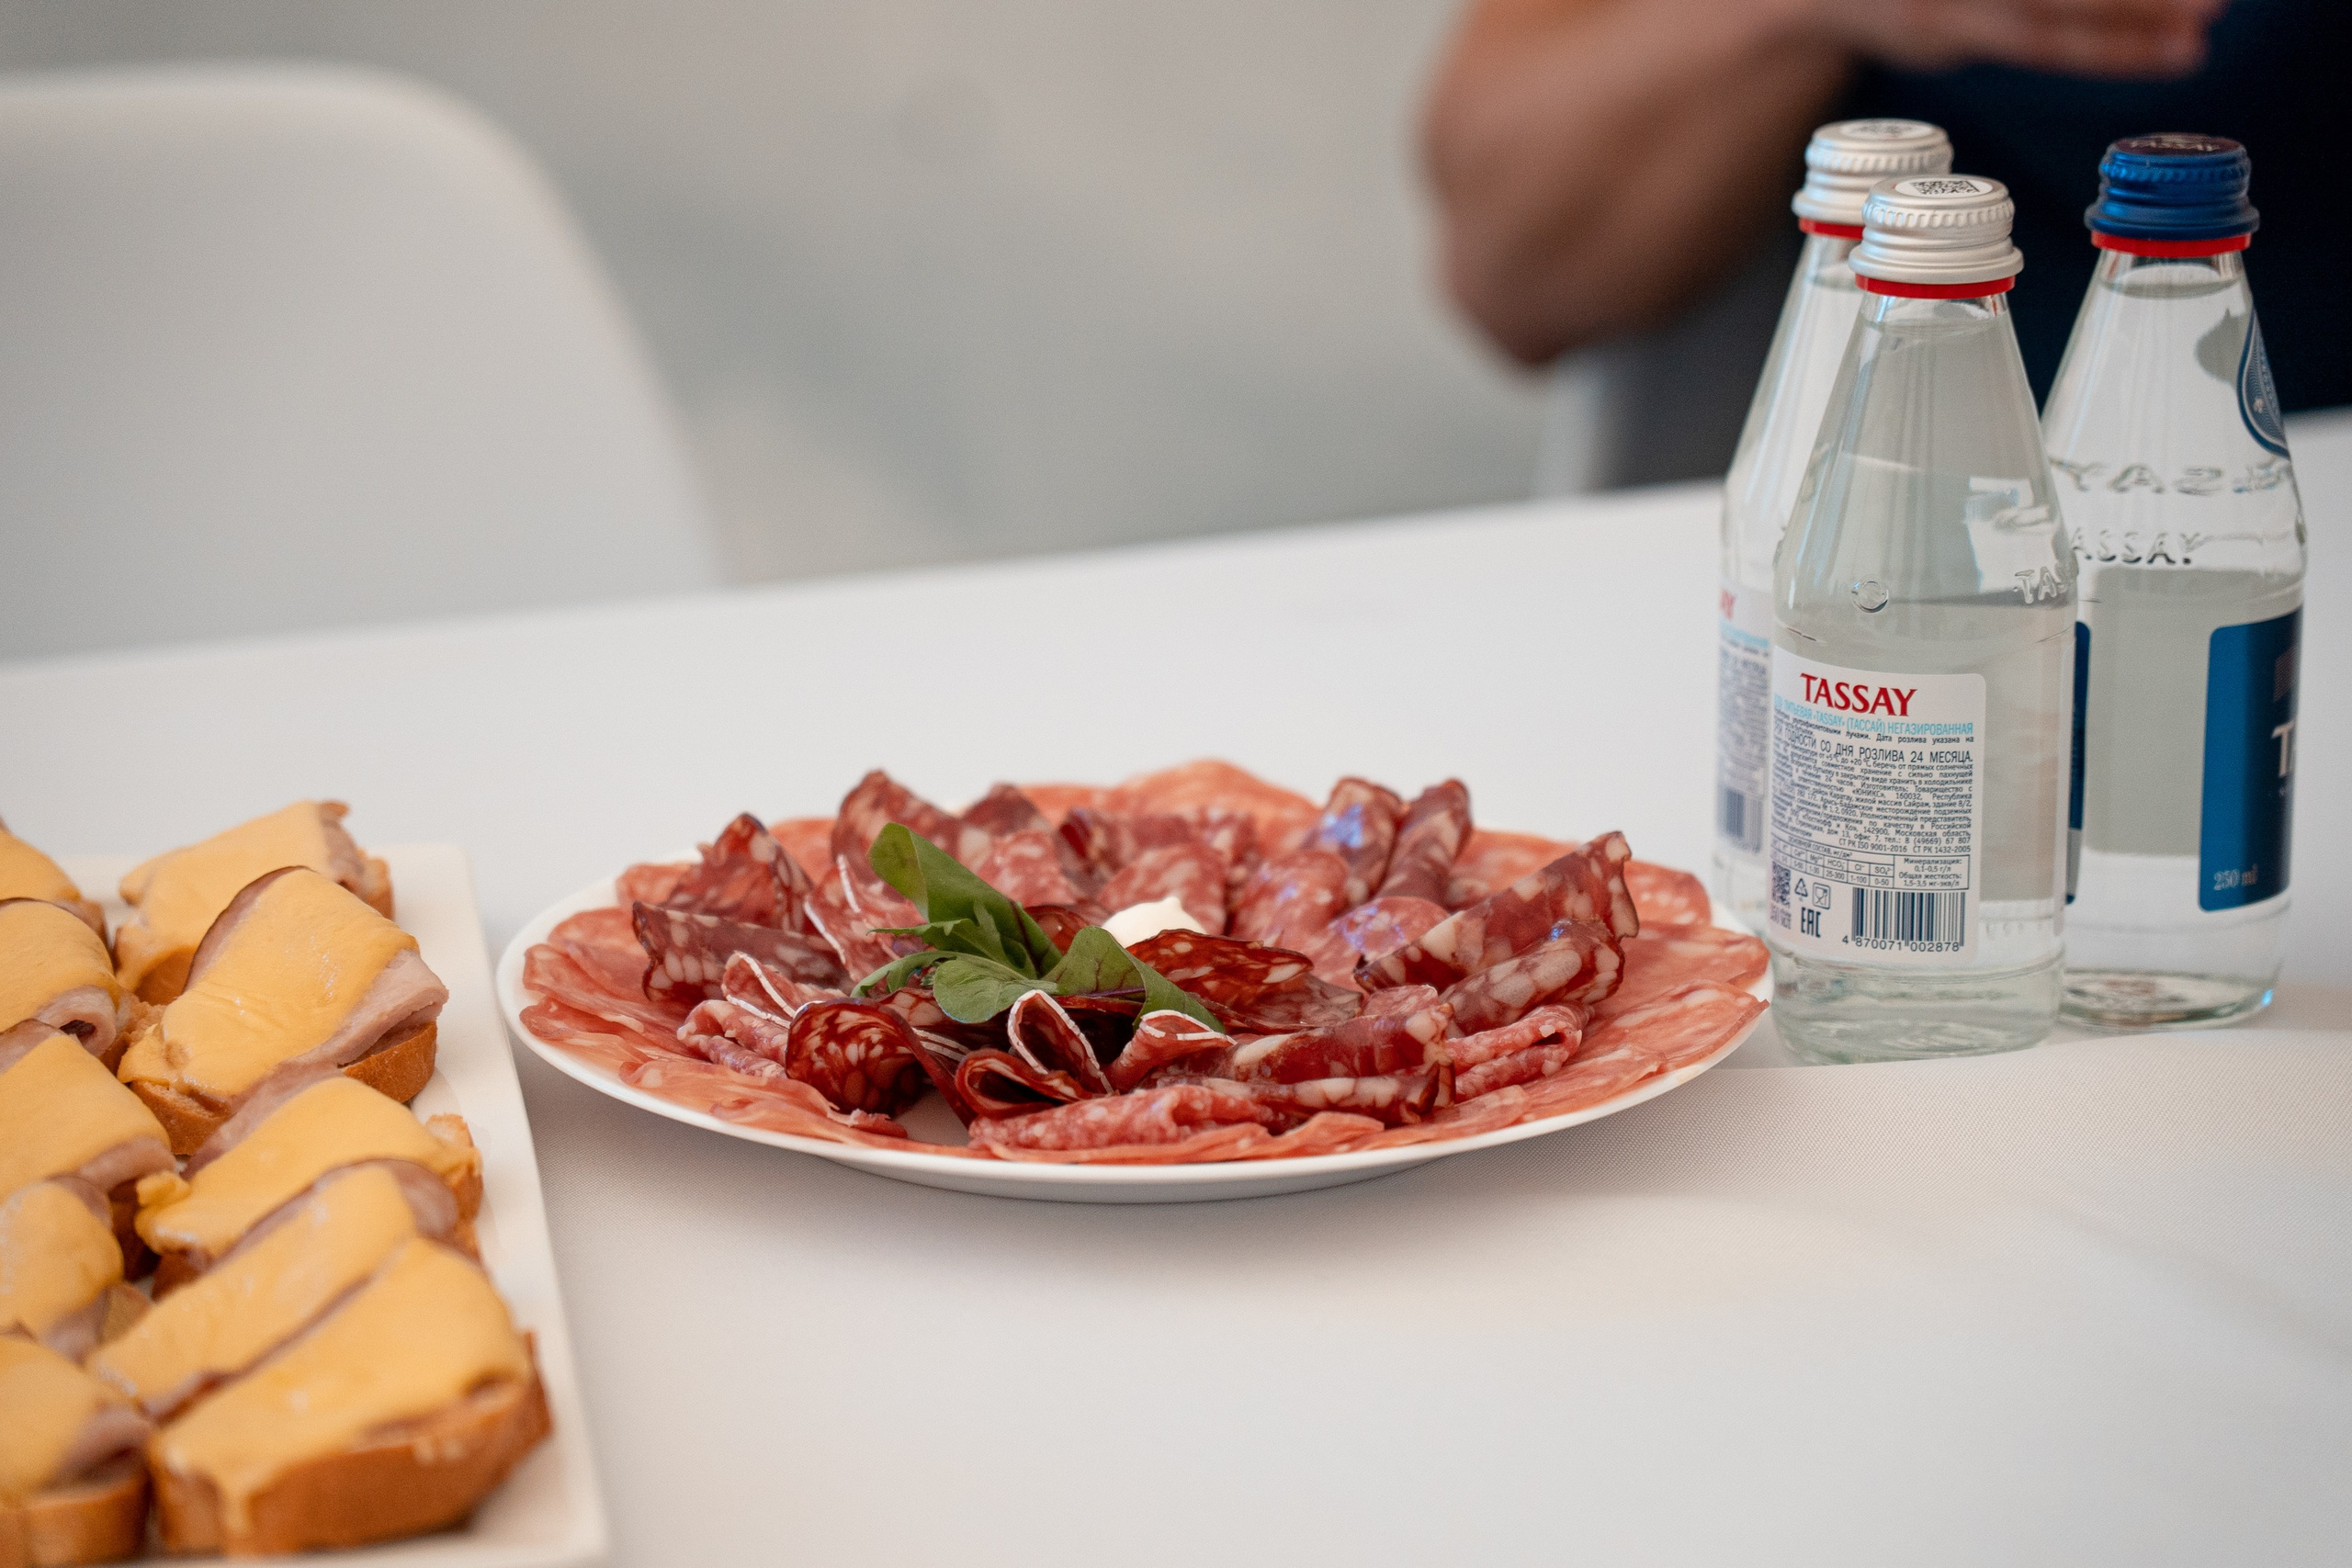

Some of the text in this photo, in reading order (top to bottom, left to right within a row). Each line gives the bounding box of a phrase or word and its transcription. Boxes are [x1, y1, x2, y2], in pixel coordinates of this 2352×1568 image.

[1800, 672, 1917, 716] TASSAY
[1847, 717, 1885, 736] (ТАССАЙ)
[1888, 722, 1973, 736] НЕГАЗИРОВАННАЯ
[1846, 729, 1870, 741] лучами.
[1876, 732, 1893, 743] Дата
[1897, 736, 1927, 745] розлива
[1931, 737, 1960, 745] указана
[1820, 739, 1831, 753] СО
[1835, 742, 1853, 758] ДНЯ
[1859, 745, 1904, 762] РОЗЛИВА
[1910, 750, 1923, 763] 24
[1929, 750, 1973, 764] МЕСЯЦА.
[1840, 756, 1848, 764] до
[1849, 757, 1861, 766] +20
[1872, 760, 1896, 771] беречь
[1907, 763, 1934, 772] прямых
[1935, 762, 1973, 771] солнечных
[1939, 770, 1973, 779] пахнущей
[1824, 773, 1832, 783] 24
[1836, 777, 1856, 787] часов.
[1860, 781, 1908, 793] Изготовитель:
[1914, 784, 1962, 793] Товарищество
[1931, 792, 1972, 801] Республика
[1877, 798, 1902, 807] массив
[1876, 806, 1930, 815] месторождение
[1859, 810, 1918, 823] Уполномоченный
[1883, 821, 1914, 831] качеству
[1853, 832, 1871, 842] офис
[1894, 829, 1937, 837] Московская
[1857, 840, 1868, 850] ISO
[1870, 842, 1907, 852] 9001-2016
[1934, 845, 1971, 853] 1432-2005
[1904, 857, 1962, 865] Минерализация:
[1914, 864, 1939, 873] 0,1-0,5
[1898, 871, 1922, 880] Общая
[2213, 869, 2240, 891] 250
[1904, 879, 1927, 887] 1,5-3,5
[1801, 907, 1822, 938] EAC
[1842, 935, 1961, 953] 4 870071 002878
